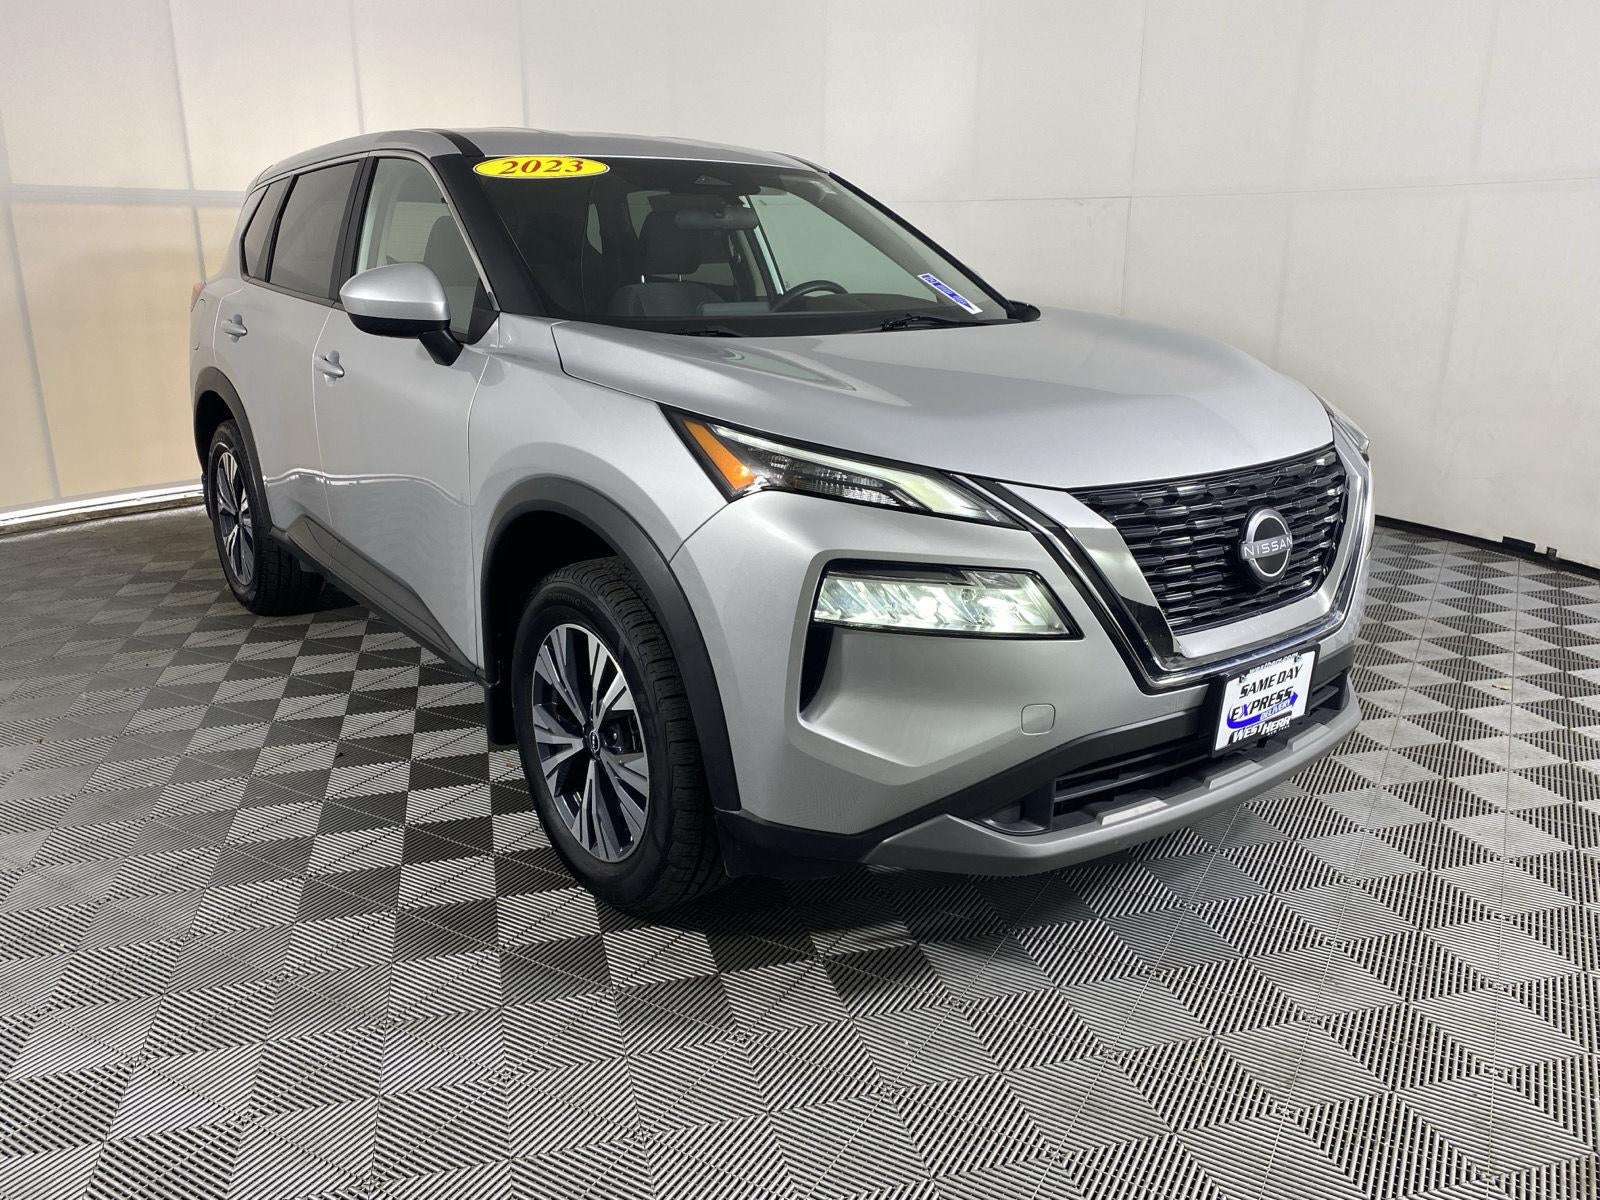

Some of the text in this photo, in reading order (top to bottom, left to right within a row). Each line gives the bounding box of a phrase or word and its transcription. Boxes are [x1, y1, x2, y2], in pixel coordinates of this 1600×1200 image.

[498, 160, 584, 174] 2023
[1244, 536, 1292, 557] NISSAN
[1239, 664, 1303, 699] SAME DAY
[1231, 686, 1294, 721] EXPRESS
